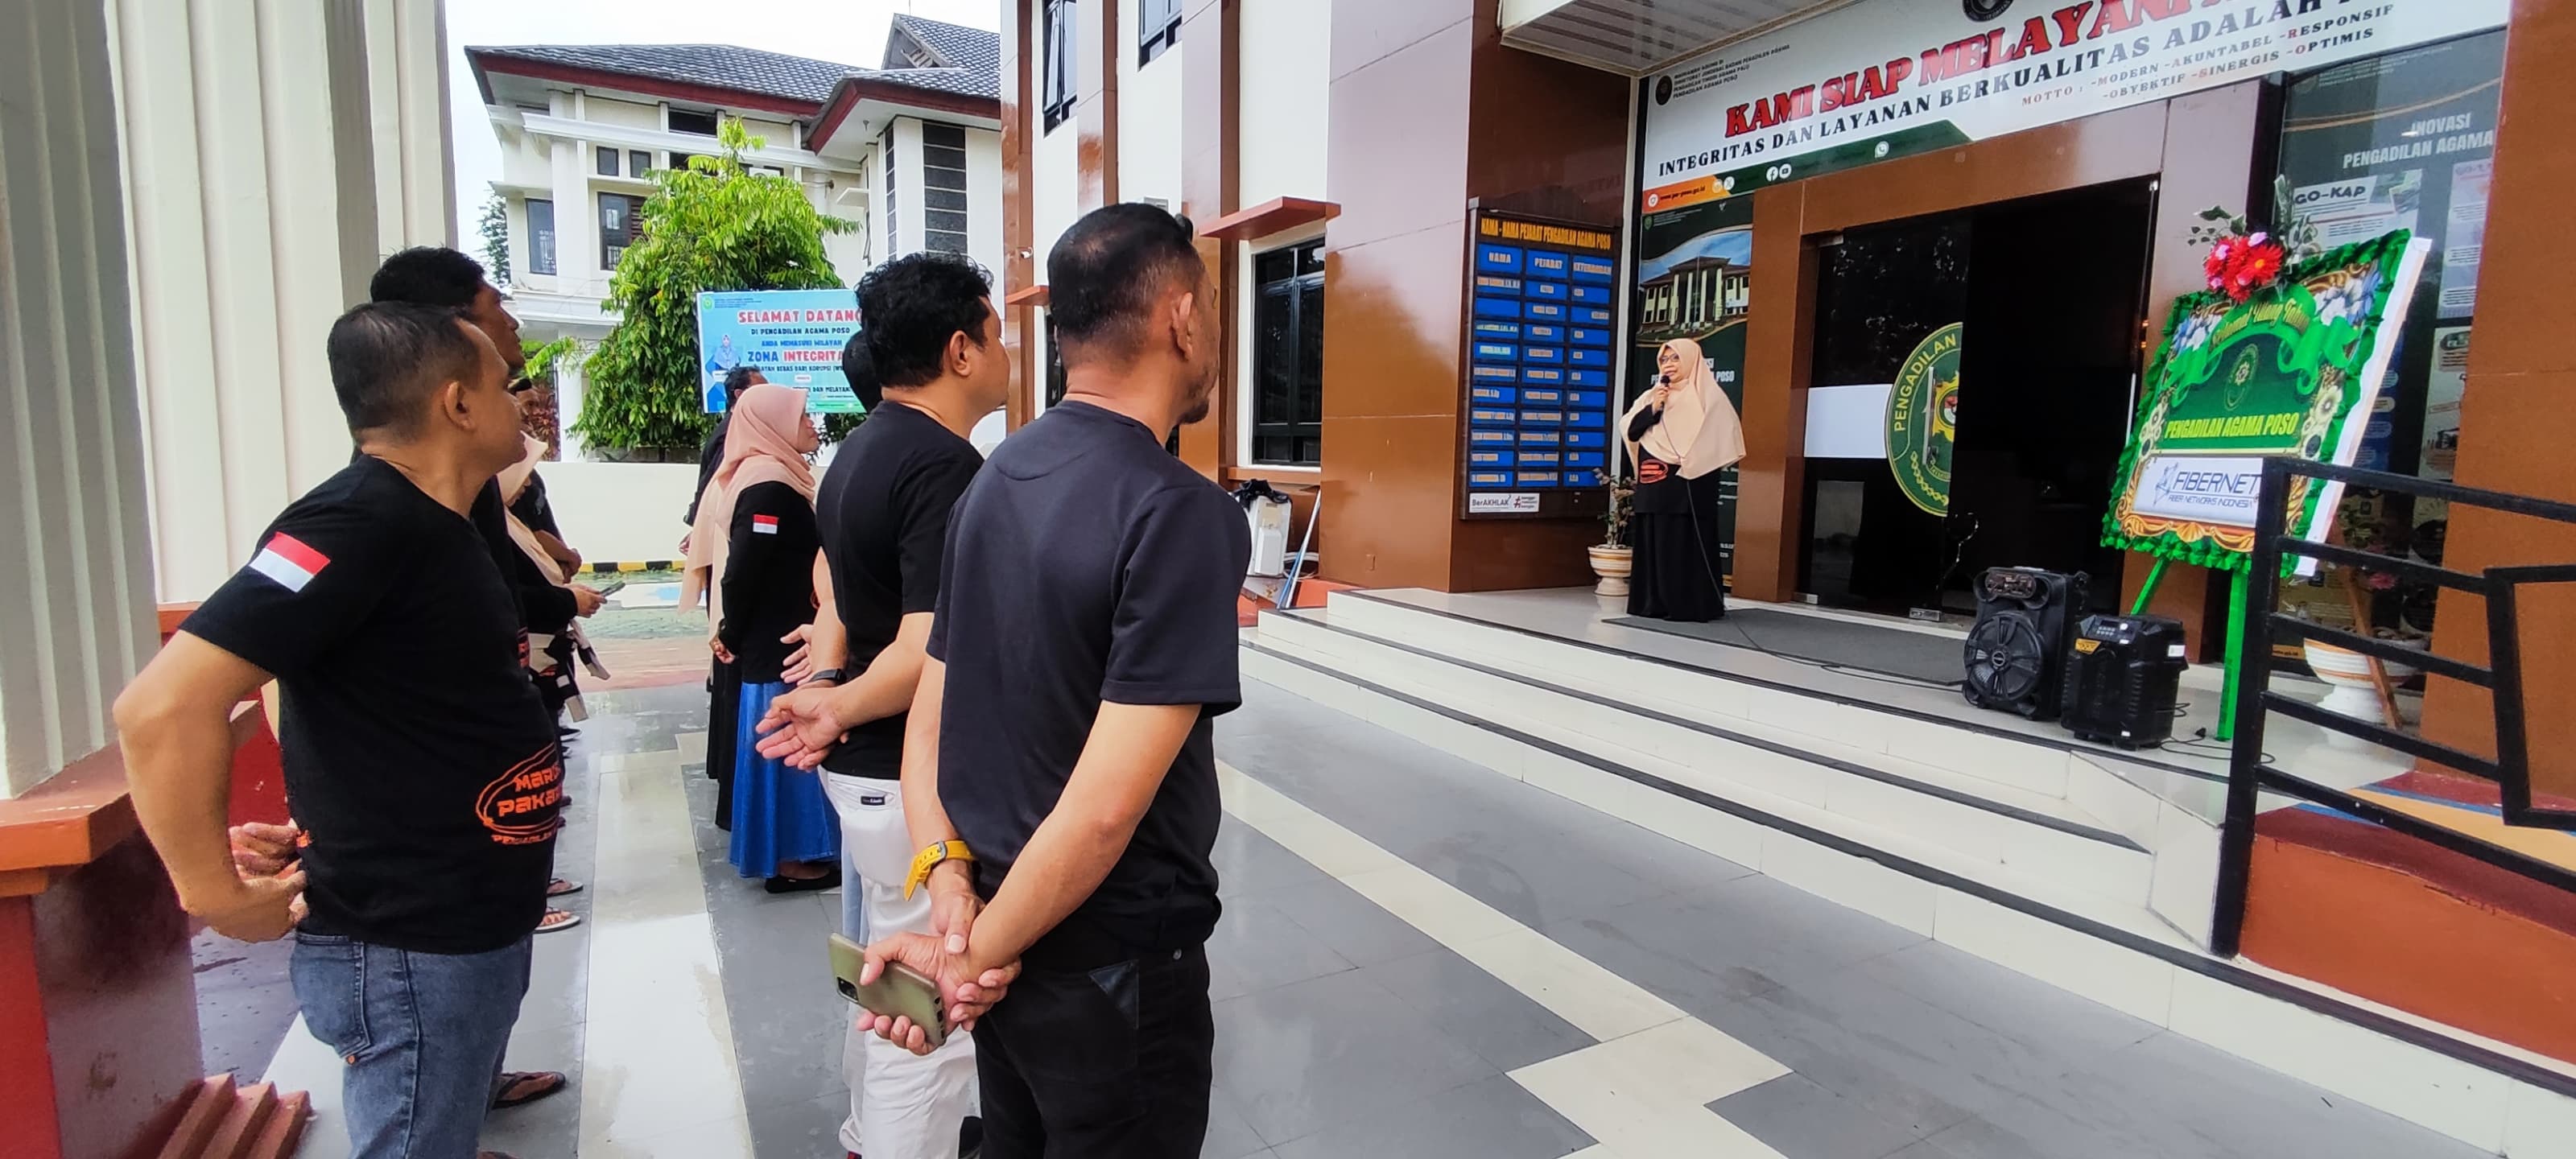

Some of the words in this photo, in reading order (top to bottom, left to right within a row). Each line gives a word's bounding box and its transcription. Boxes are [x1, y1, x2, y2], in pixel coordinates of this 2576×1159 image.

[2022, 87, 2074, 106] MOTTO
[2164, 35, 2273, 68] -AKUNTABEL
[2280, 4, 2394, 39] -RESPONSIF
[2190, 51, 2280, 78] -SINERGIS
[2286, 28, 2373, 55] -OPTIMIS
[1658, 138, 1765, 176] INTEGRITAS
[1773, 125, 1813, 149] DAN
[1820, 94, 1930, 137] LAYANAN
[1939, 36, 2150, 107] BERKUALITAS
[2163, 0, 2322, 50] ADALAH
[1724, 84, 1816, 138] KAMI
[1820, 57, 1913, 113] SIAP
[2412, 113, 2471, 136] INOVASI
[2343, 140, 2433, 168] PENGADILAN
[2436, 130, 2493, 154] AGAMA
[2295, 186, 2366, 204] GO-KAP
[1577, 230, 1596, 248] AGAMA
[1596, 233, 1611, 250] POSO
[738, 311, 799, 323] SELAMAT
[748, 351, 778, 362] ZONA
[784, 351, 844, 361] INTEGRITA
[1716, 371, 1735, 382] POSO
[1893, 333, 1956, 431] PENGADILAN
[2165, 418, 2225, 439] PENGADILAN
[2222, 415, 2265, 437] AGAMA
[2263, 412, 2299, 435] POSO
[2173, 472, 2262, 495] FIBERNET
